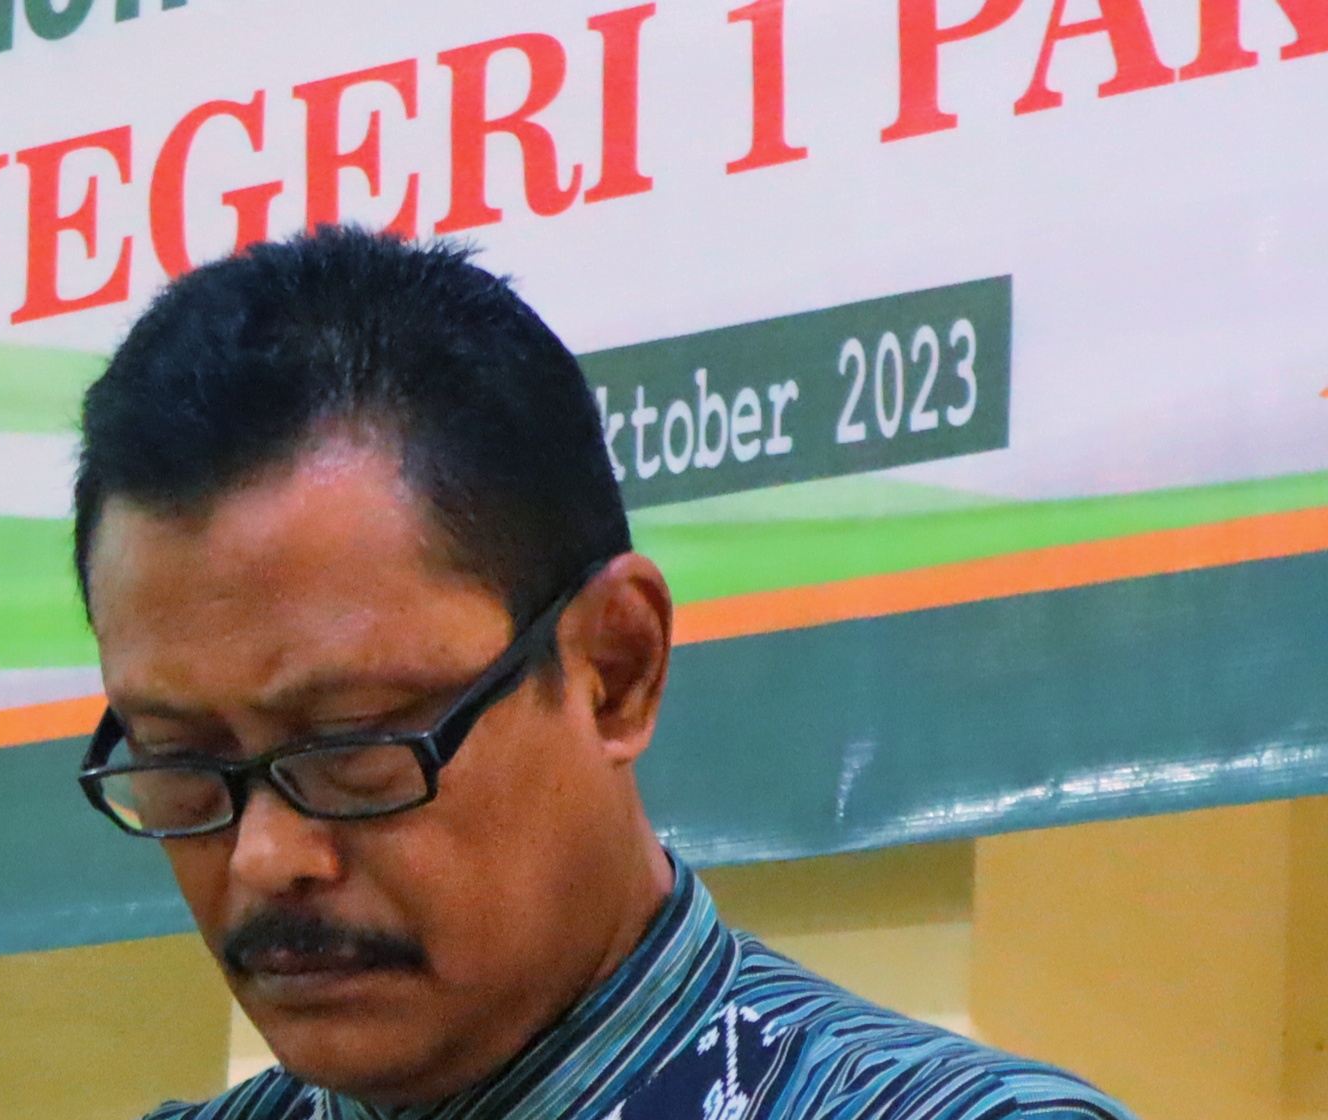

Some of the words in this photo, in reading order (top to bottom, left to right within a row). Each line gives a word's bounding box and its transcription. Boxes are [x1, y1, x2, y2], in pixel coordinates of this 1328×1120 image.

[726, 0, 808, 175] 1
[594, 368, 799, 482] ktober
[836, 318, 976, 444] 2023
